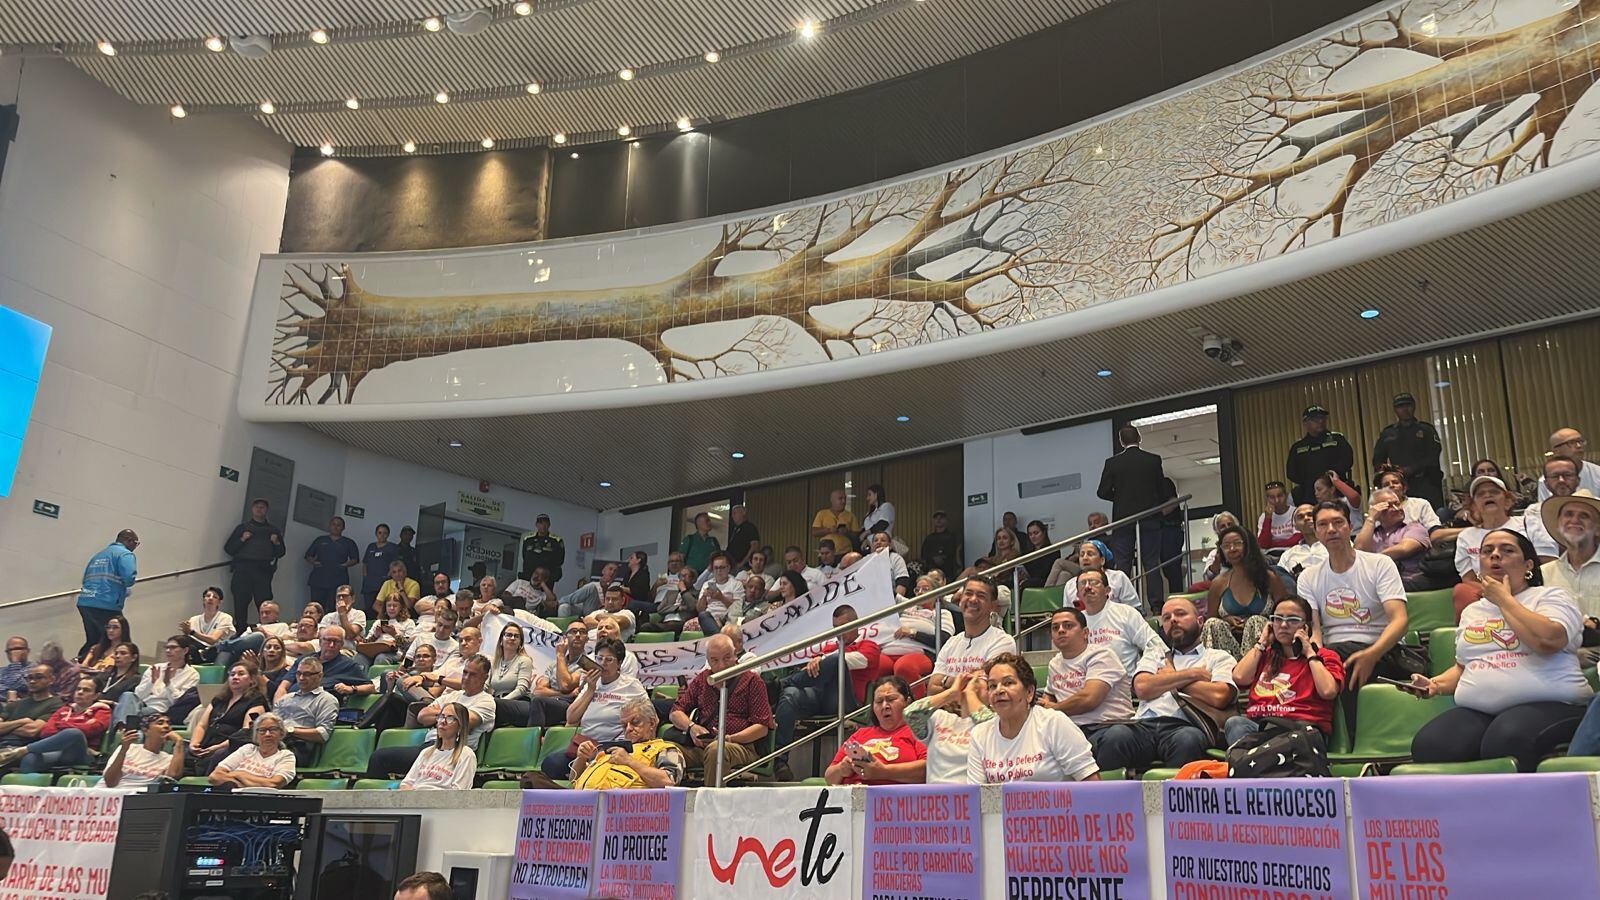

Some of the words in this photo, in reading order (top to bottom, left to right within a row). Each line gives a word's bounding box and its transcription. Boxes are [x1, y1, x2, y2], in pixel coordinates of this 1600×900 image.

[86, 797, 99, 816] DE
[101, 797, 120, 817] LAS
[607, 793, 617, 813] LA
[619, 791, 671, 813] AUSTERIDAD
[873, 796, 893, 822] LAS
[896, 795, 949, 822] MUJERES
[953, 794, 970, 820] DE
[1004, 789, 1050, 813] QUEREMOS
[1053, 788, 1073, 808] UNA
[1168, 787, 1220, 813] CONTRA
[1225, 788, 1241, 815] EL
[1247, 788, 1337, 818] RETROCESO
[21, 817, 56, 840] LUCHA
[58, 820, 74, 841] DE
[521, 817, 533, 838] NO
[535, 818, 546, 838] SE
[548, 819, 593, 841] NEGOCIAN
[605, 816, 614, 832] DE
[616, 816, 623, 832] LA
[1005, 810, 1080, 844] SECRETARÍA
[1084, 814, 1101, 842] DE
[1107, 812, 1135, 842] LAS
[1169, 821, 1175, 839] Y
[1178, 822, 1214, 841] CONTRA
[1216, 822, 1229, 842] LA
[1232, 823, 1341, 849] REESTRUCTURACIÓN
[1364, 820, 1383, 838] LOS
[1385, 818, 1440, 838] DERECHOS
[603, 835, 618, 860] NO
[622, 835, 668, 861] PROTEGE
[873, 826, 912, 847] ANTIOQUIA
[914, 826, 949, 844] SALIMOS
[951, 826, 958, 843] A
[961, 826, 971, 843] LA
[518, 840, 530, 860] NO
[533, 840, 543, 861] SE
[545, 841, 591, 863] RECORTAN
[873, 851, 898, 872] CALLE
[902, 852, 920, 872] POR
[922, 849, 974, 874] GARANTÍAS
[1006, 845, 1062, 874] MUJERES
[1067, 845, 1095, 877] QUE
[1099, 845, 1129, 873] NOS
[1367, 841, 1396, 880] DE
[1401, 841, 1446, 883] LAS
[38, 865, 58, 891] DE
[57, 866, 84, 894] LAS
[86, 868, 108, 896] MU
[513, 862, 528, 884] NO
[528, 863, 588, 889] RETROCEDEN
[601, 864, 609, 880] LA
[612, 864, 627, 880] VIDA
[629, 864, 638, 880] DE
[640, 864, 653, 881] LAS
[873, 873, 922, 892] FINANCIERAS
[1172, 856, 1194, 879] POR
[1198, 857, 1258, 885] NUESTROS
[1263, 862, 1331, 892] DERECHOS
[1008, 877, 1124, 900] REPRESENTE
[1174, 881, 1312, 900] CONQUI
